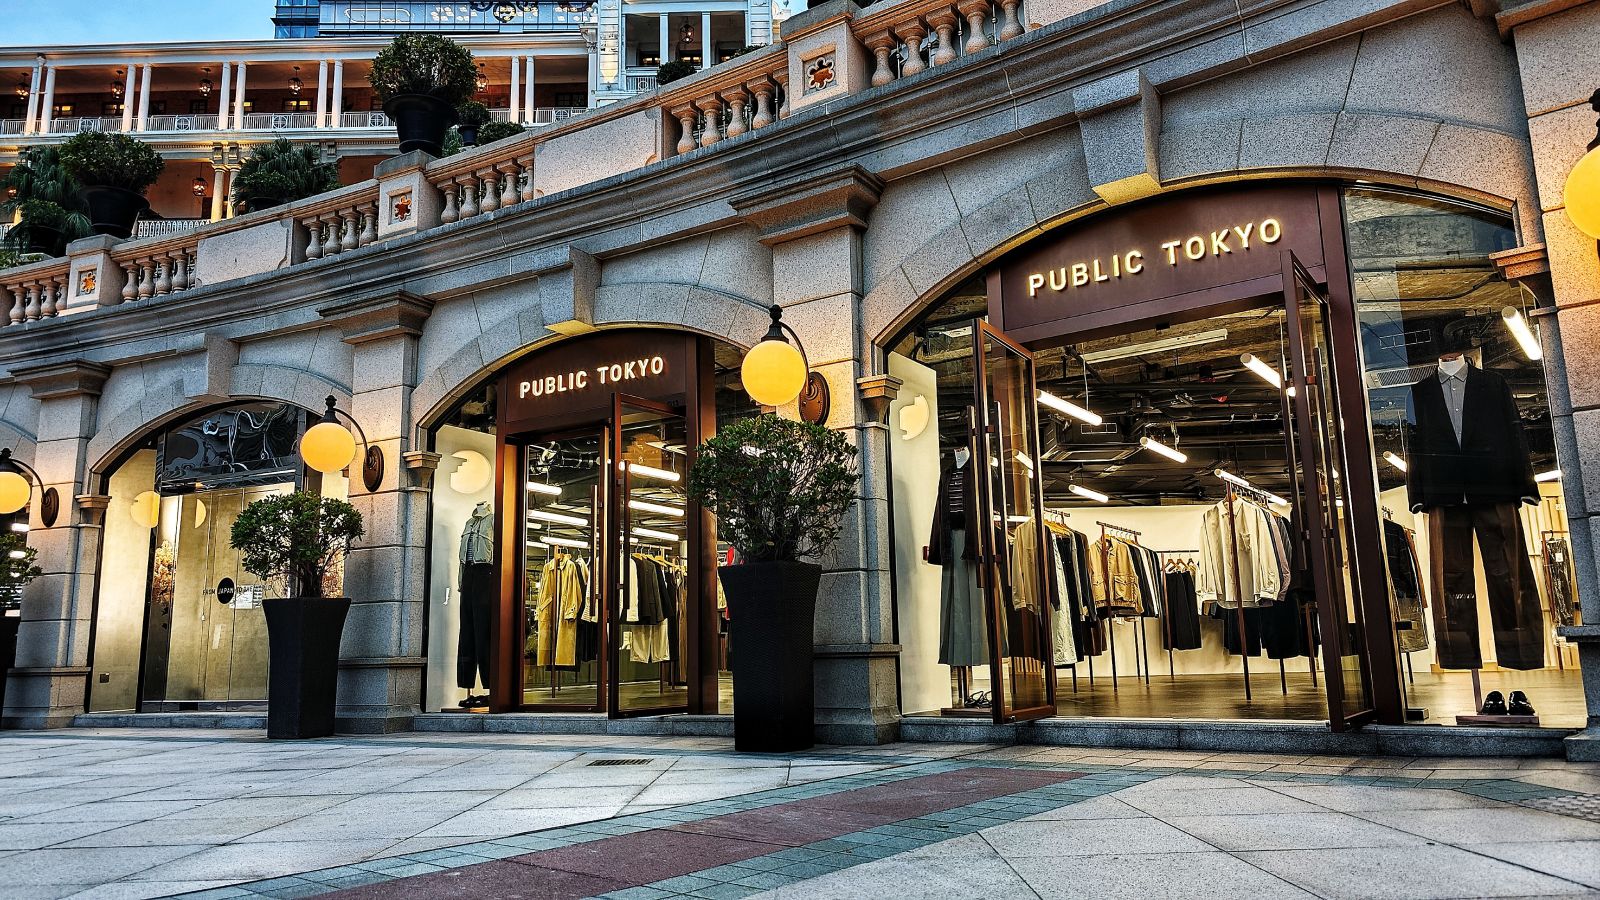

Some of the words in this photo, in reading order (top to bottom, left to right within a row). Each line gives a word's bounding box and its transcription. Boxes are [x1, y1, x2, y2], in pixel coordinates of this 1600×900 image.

[1028, 250, 1143, 297] PUBLIC
[1162, 218, 1281, 266] TOKYO
[519, 370, 588, 399] PUBLIC
[597, 356, 664, 384] TOKYO
[218, 587, 234, 595] JAPAN
